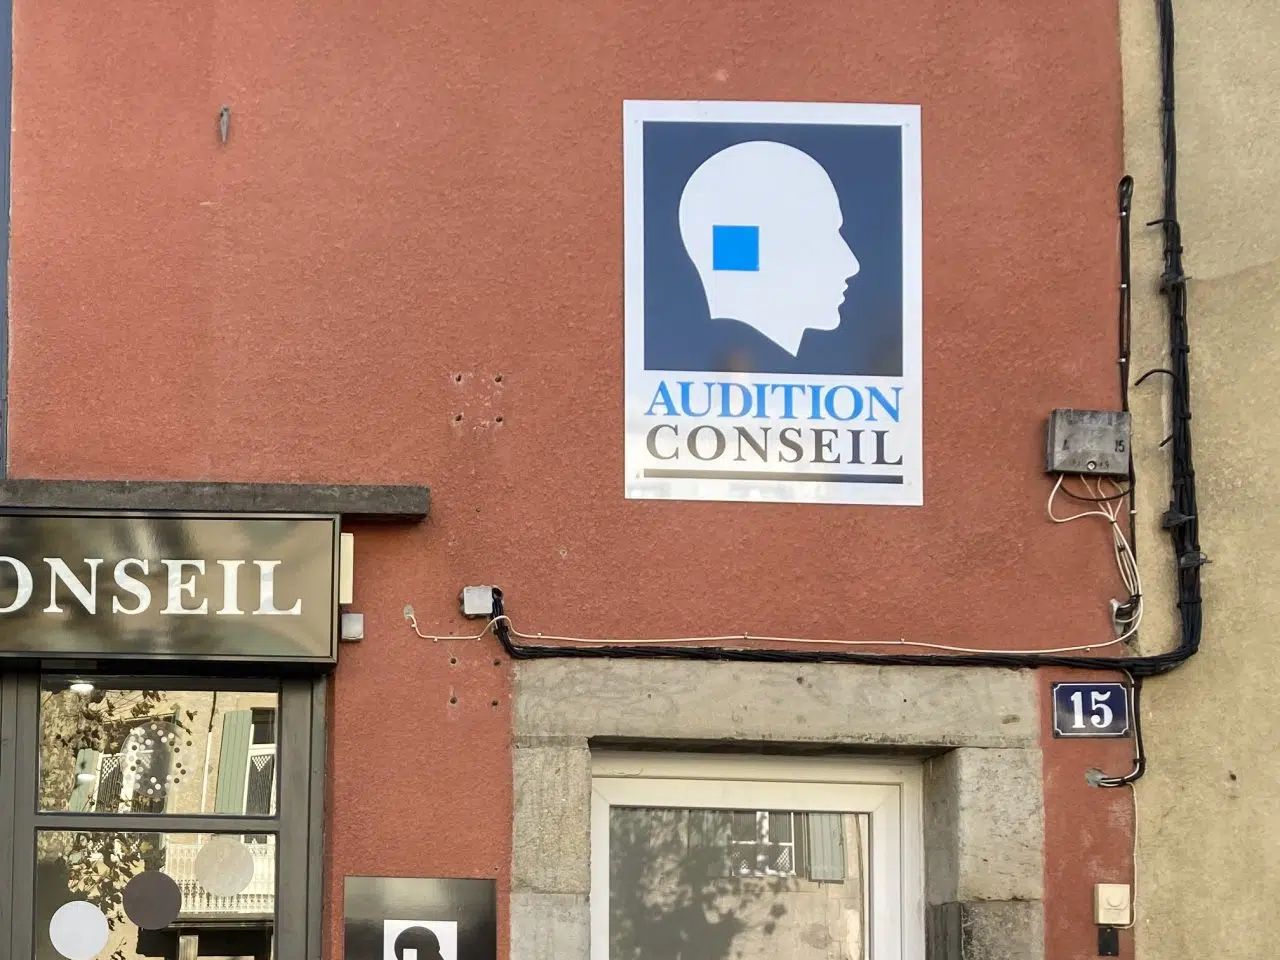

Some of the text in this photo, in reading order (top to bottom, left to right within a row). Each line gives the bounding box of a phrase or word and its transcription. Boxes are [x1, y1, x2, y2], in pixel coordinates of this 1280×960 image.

[644, 380, 903, 423] AUDITION
[646, 424, 903, 466] CONSEIL
[1070, 690, 1114, 730] 15
